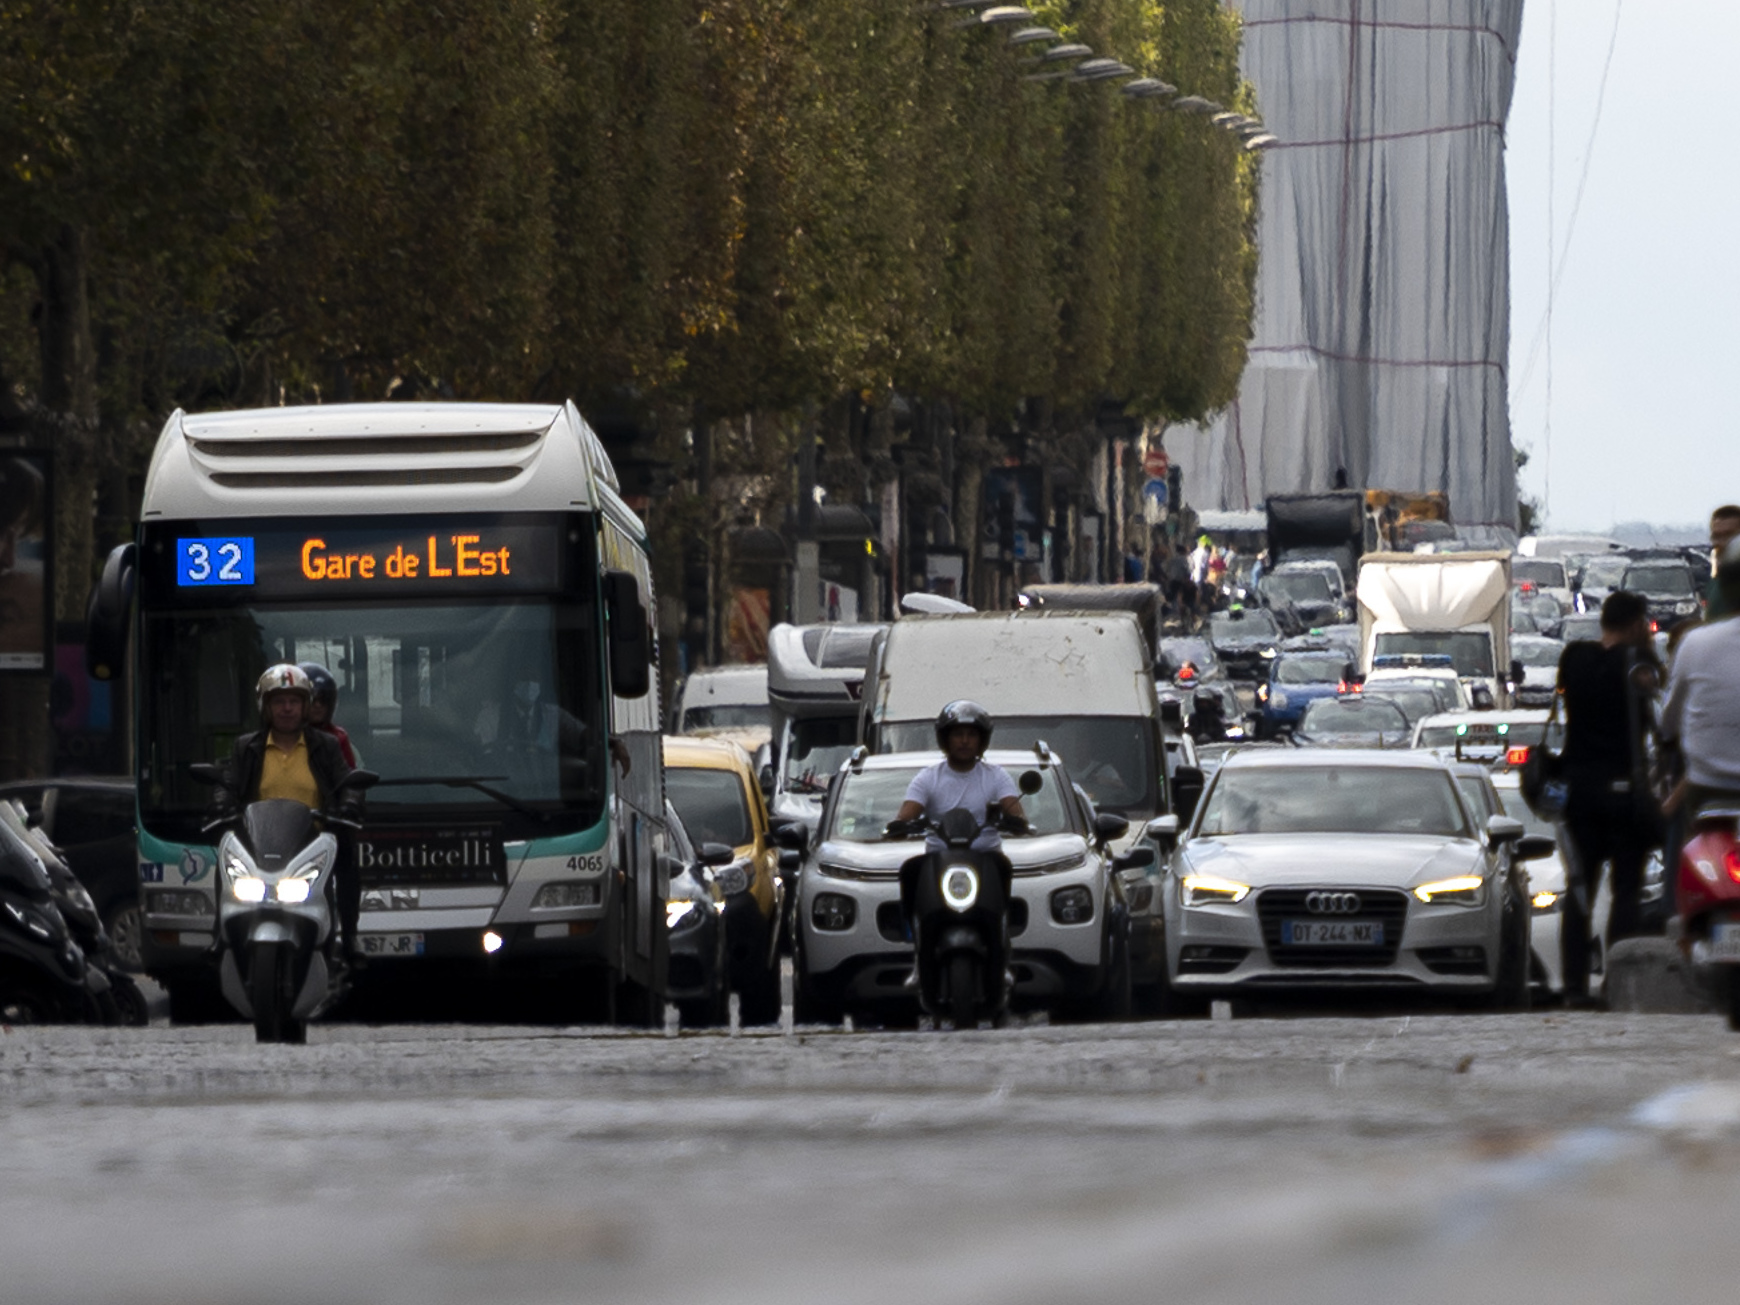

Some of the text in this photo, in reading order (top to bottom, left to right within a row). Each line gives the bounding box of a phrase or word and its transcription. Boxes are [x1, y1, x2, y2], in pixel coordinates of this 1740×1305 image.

[187, 542, 243, 581] 32
[301, 535, 510, 580] Gare de L'Est
[357, 839, 491, 868] Botticelli
[566, 856, 603, 872] 4065
